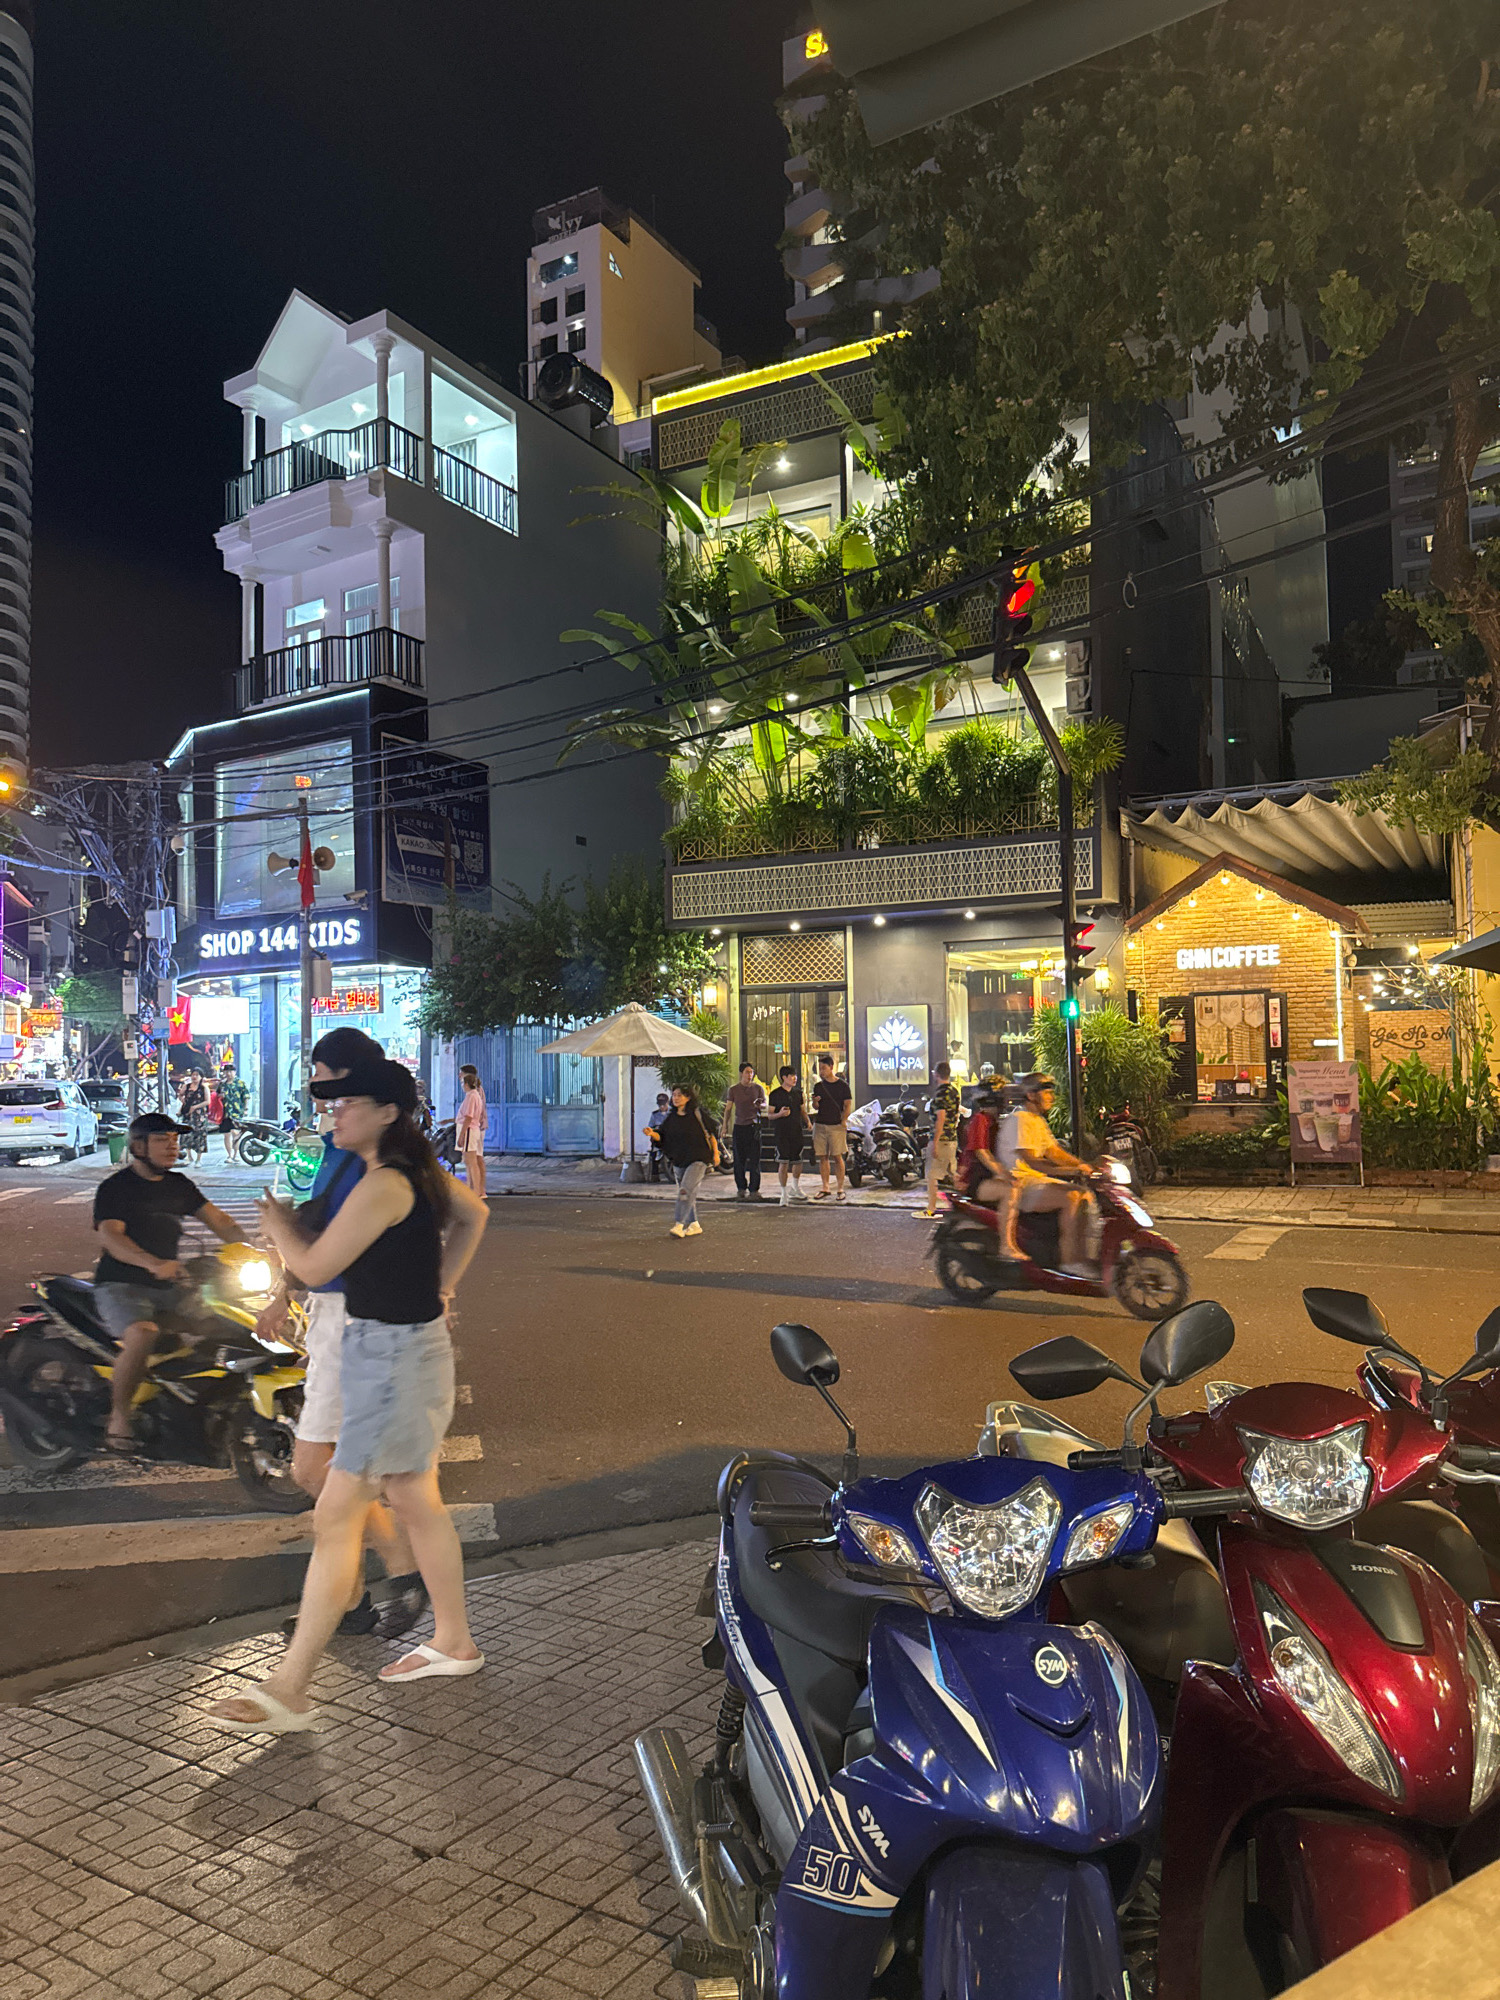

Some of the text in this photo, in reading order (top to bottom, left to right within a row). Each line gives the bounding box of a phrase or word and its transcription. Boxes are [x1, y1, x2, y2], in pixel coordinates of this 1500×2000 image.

[200, 919, 361, 958] SHOP 144 KIDS
[1177, 944, 1280, 970] GHN COFFEE
[871, 1057, 924, 1070] Well SPA
[1350, 1564, 1398, 1576] HONDA
[1039, 1659, 1065, 1674] SYM
[857, 1805, 890, 1859] SYM
[802, 1845, 862, 1899] 50
